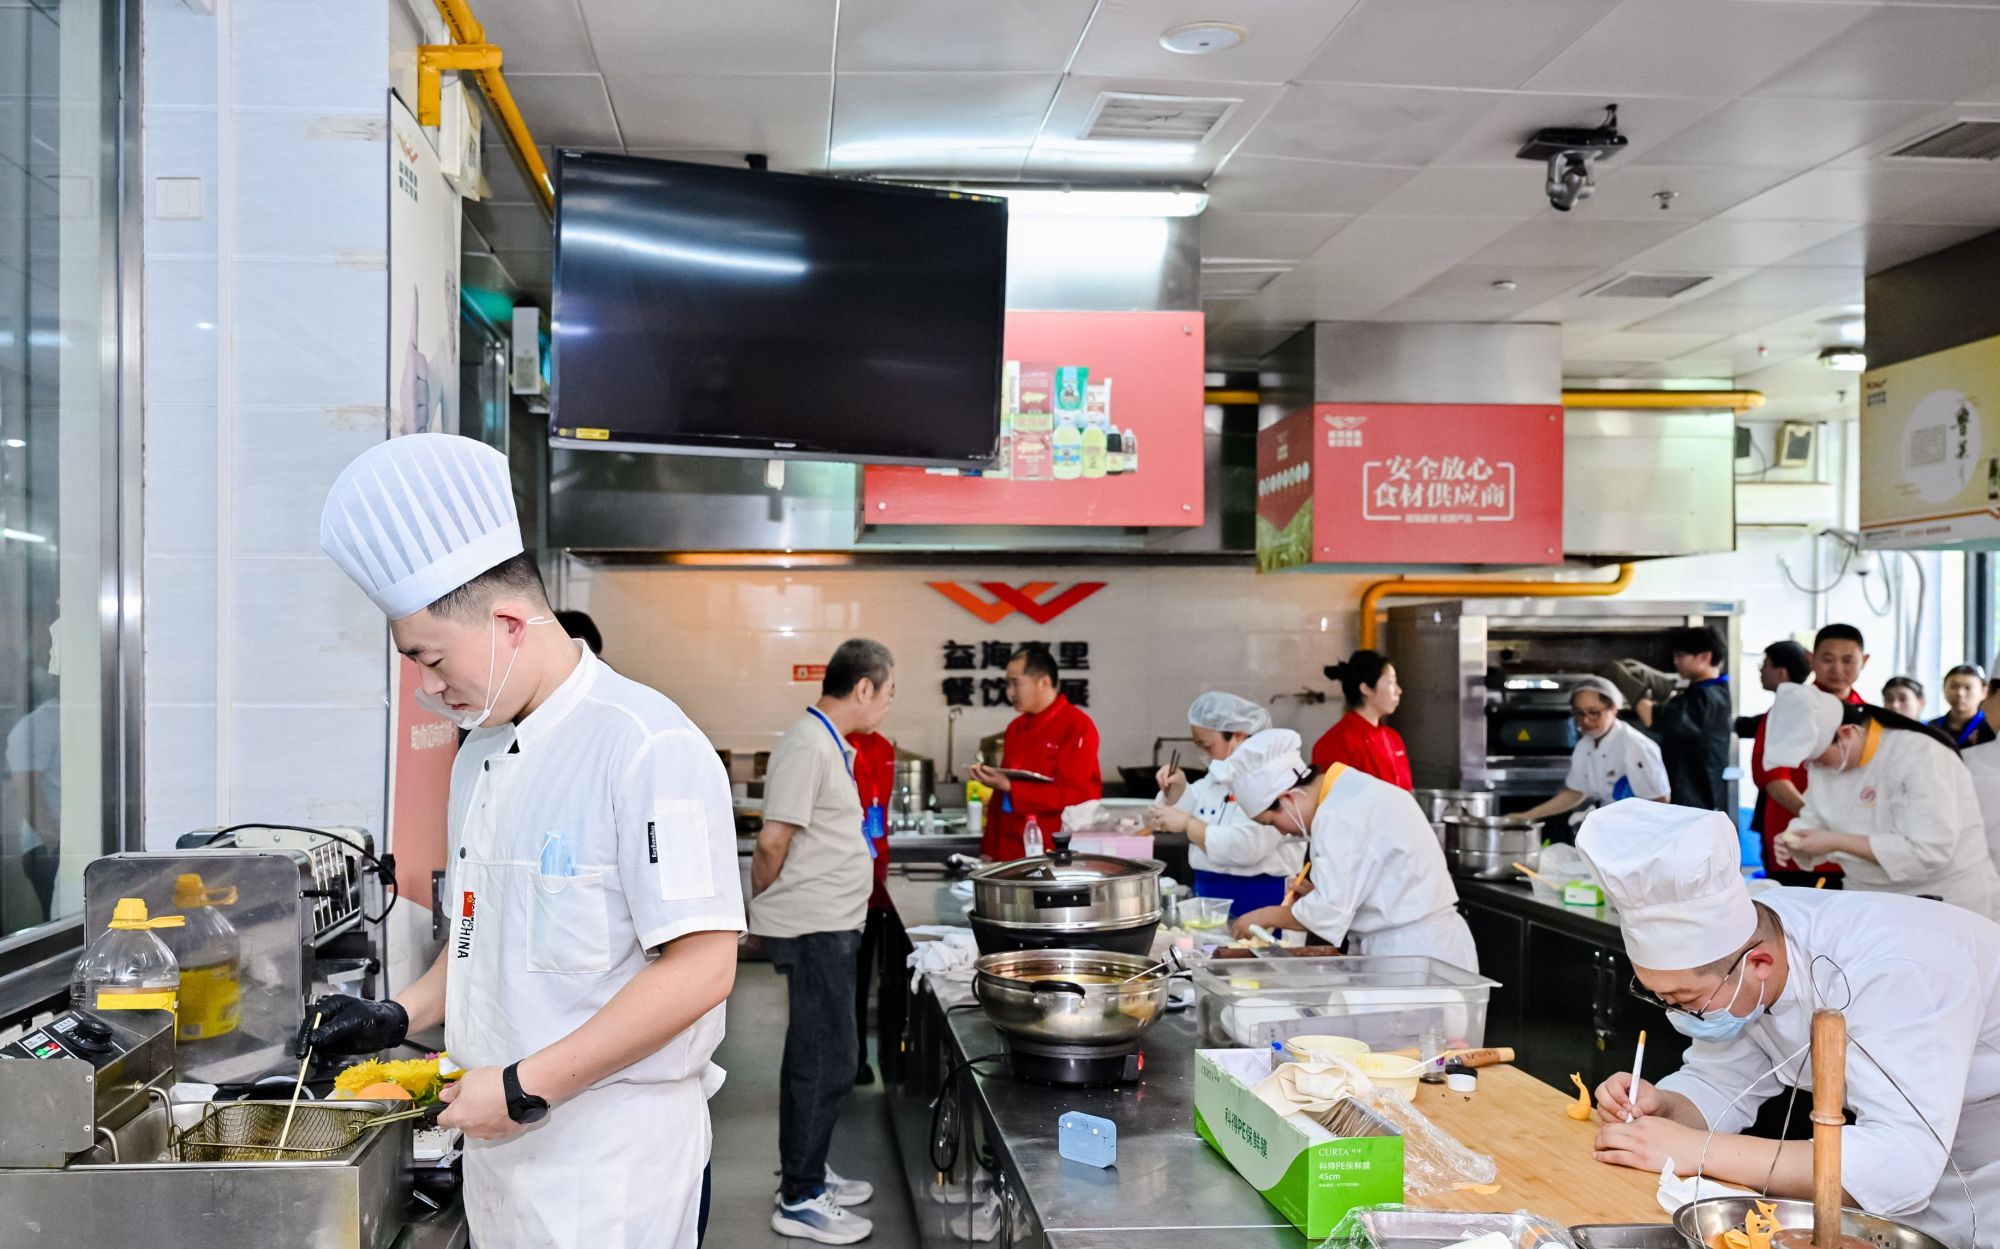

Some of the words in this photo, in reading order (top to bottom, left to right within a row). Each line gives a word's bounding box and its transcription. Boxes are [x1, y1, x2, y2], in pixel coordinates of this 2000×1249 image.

[1385, 455, 1494, 481] 安全放心
[1374, 482, 1505, 508] 食材供应商
[942, 640, 1090, 670] 益海里
[942, 677, 1090, 707] 餐饮展
[457, 919, 472, 959] CHINA
[1318, 1148, 1349, 1157] CURTA
[1318, 1173, 1341, 1181] 45cm
